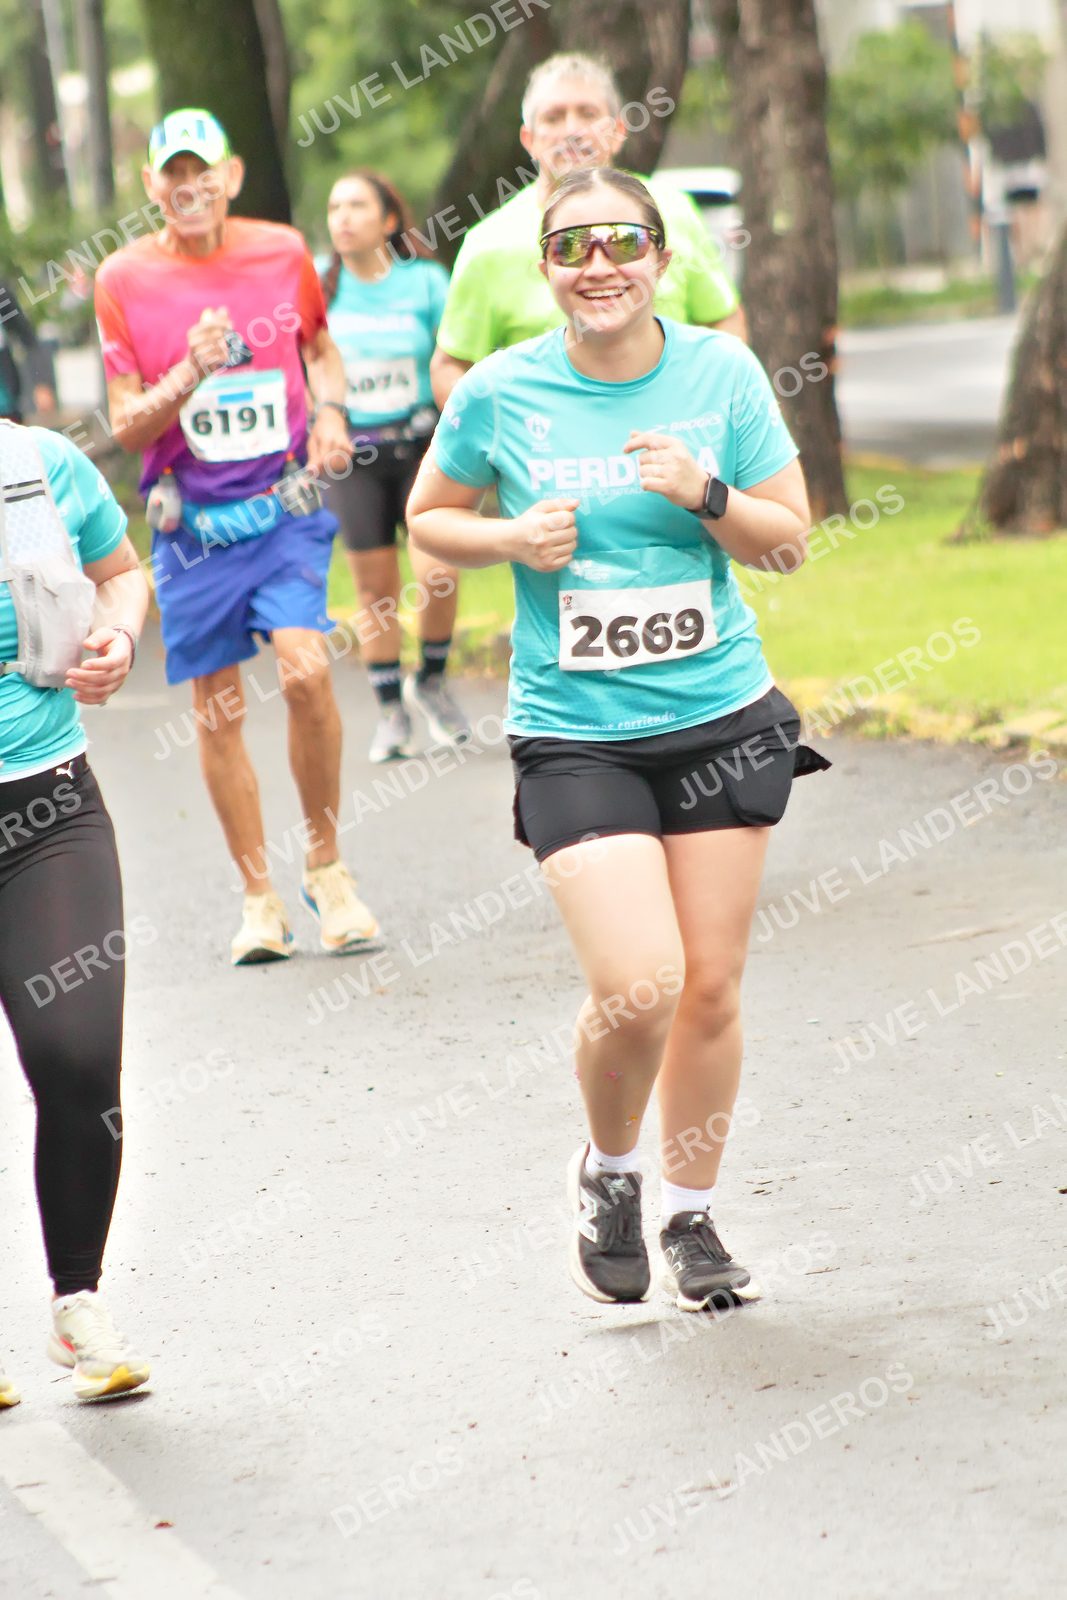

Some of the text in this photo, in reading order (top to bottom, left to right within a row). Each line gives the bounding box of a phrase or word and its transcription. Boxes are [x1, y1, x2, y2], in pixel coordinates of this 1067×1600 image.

[191, 404, 275, 435] 6191
[526, 446, 721, 490] PERDA
[570, 608, 705, 657] 2669
